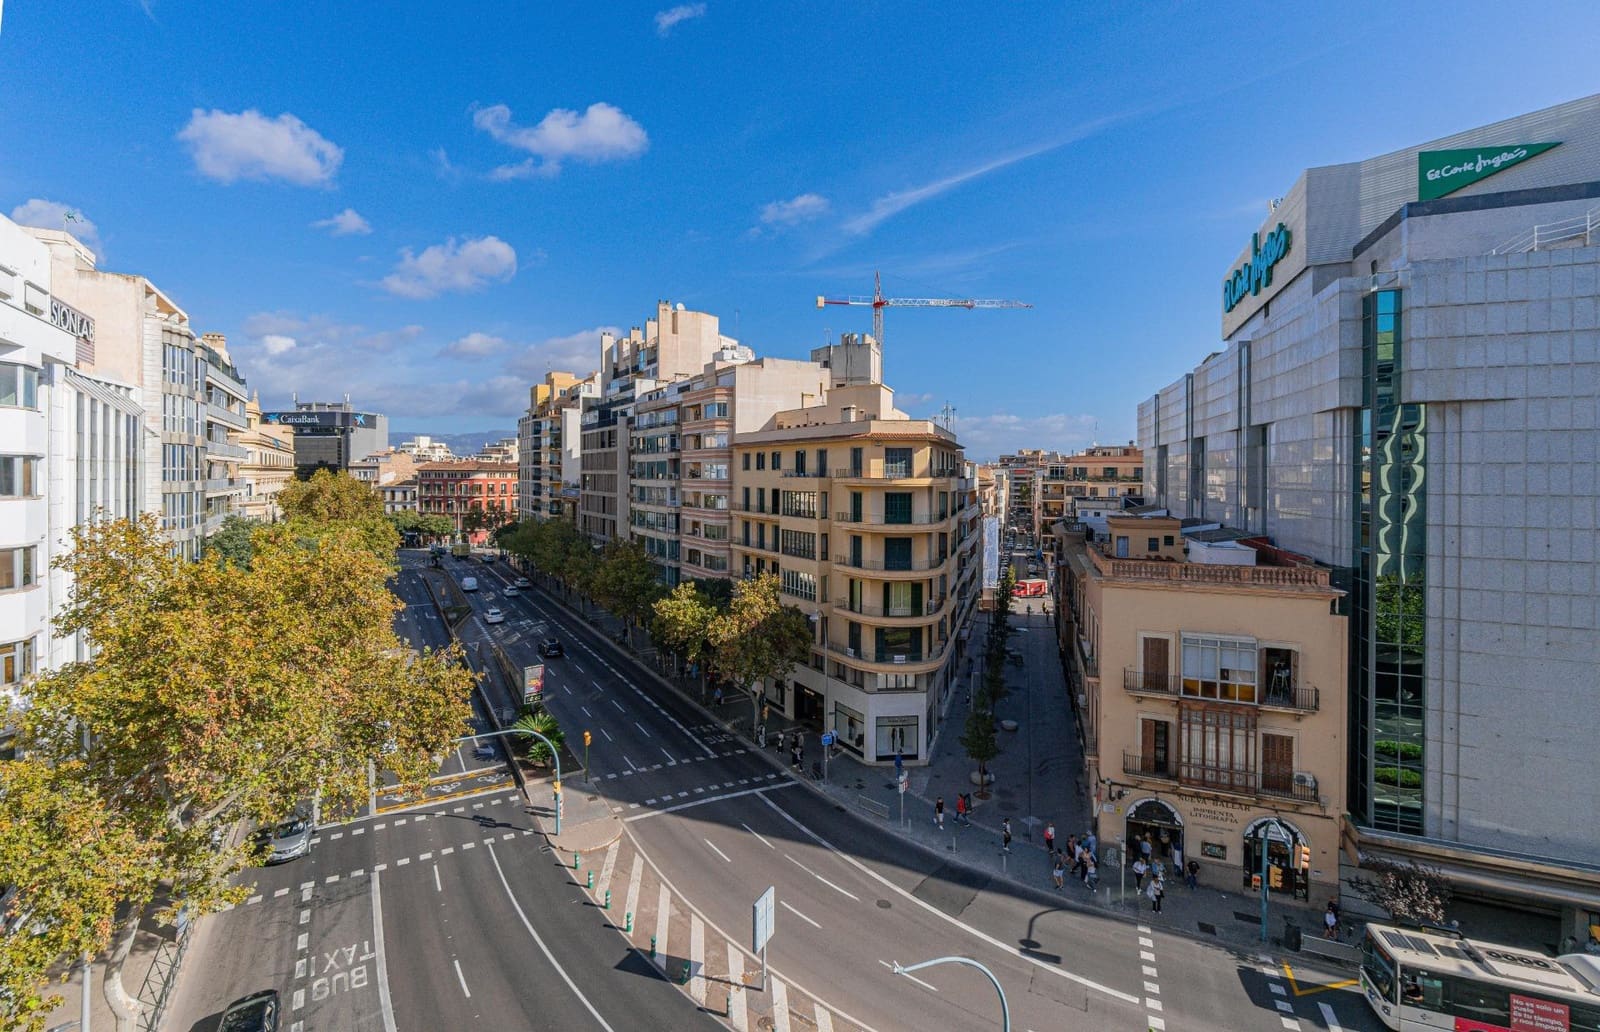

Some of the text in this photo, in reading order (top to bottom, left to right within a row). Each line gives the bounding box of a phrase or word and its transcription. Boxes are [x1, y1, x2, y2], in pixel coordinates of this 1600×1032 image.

[1426, 169, 1440, 181] El
[1441, 162, 1474, 177] Corte
[280, 414, 320, 424] CaixaBank
[1178, 795, 1207, 805] NUEVA
[1193, 807, 1235, 818] IMPRENTA
[310, 941, 376, 977] TAXI
[312, 965, 368, 1001] BUS
